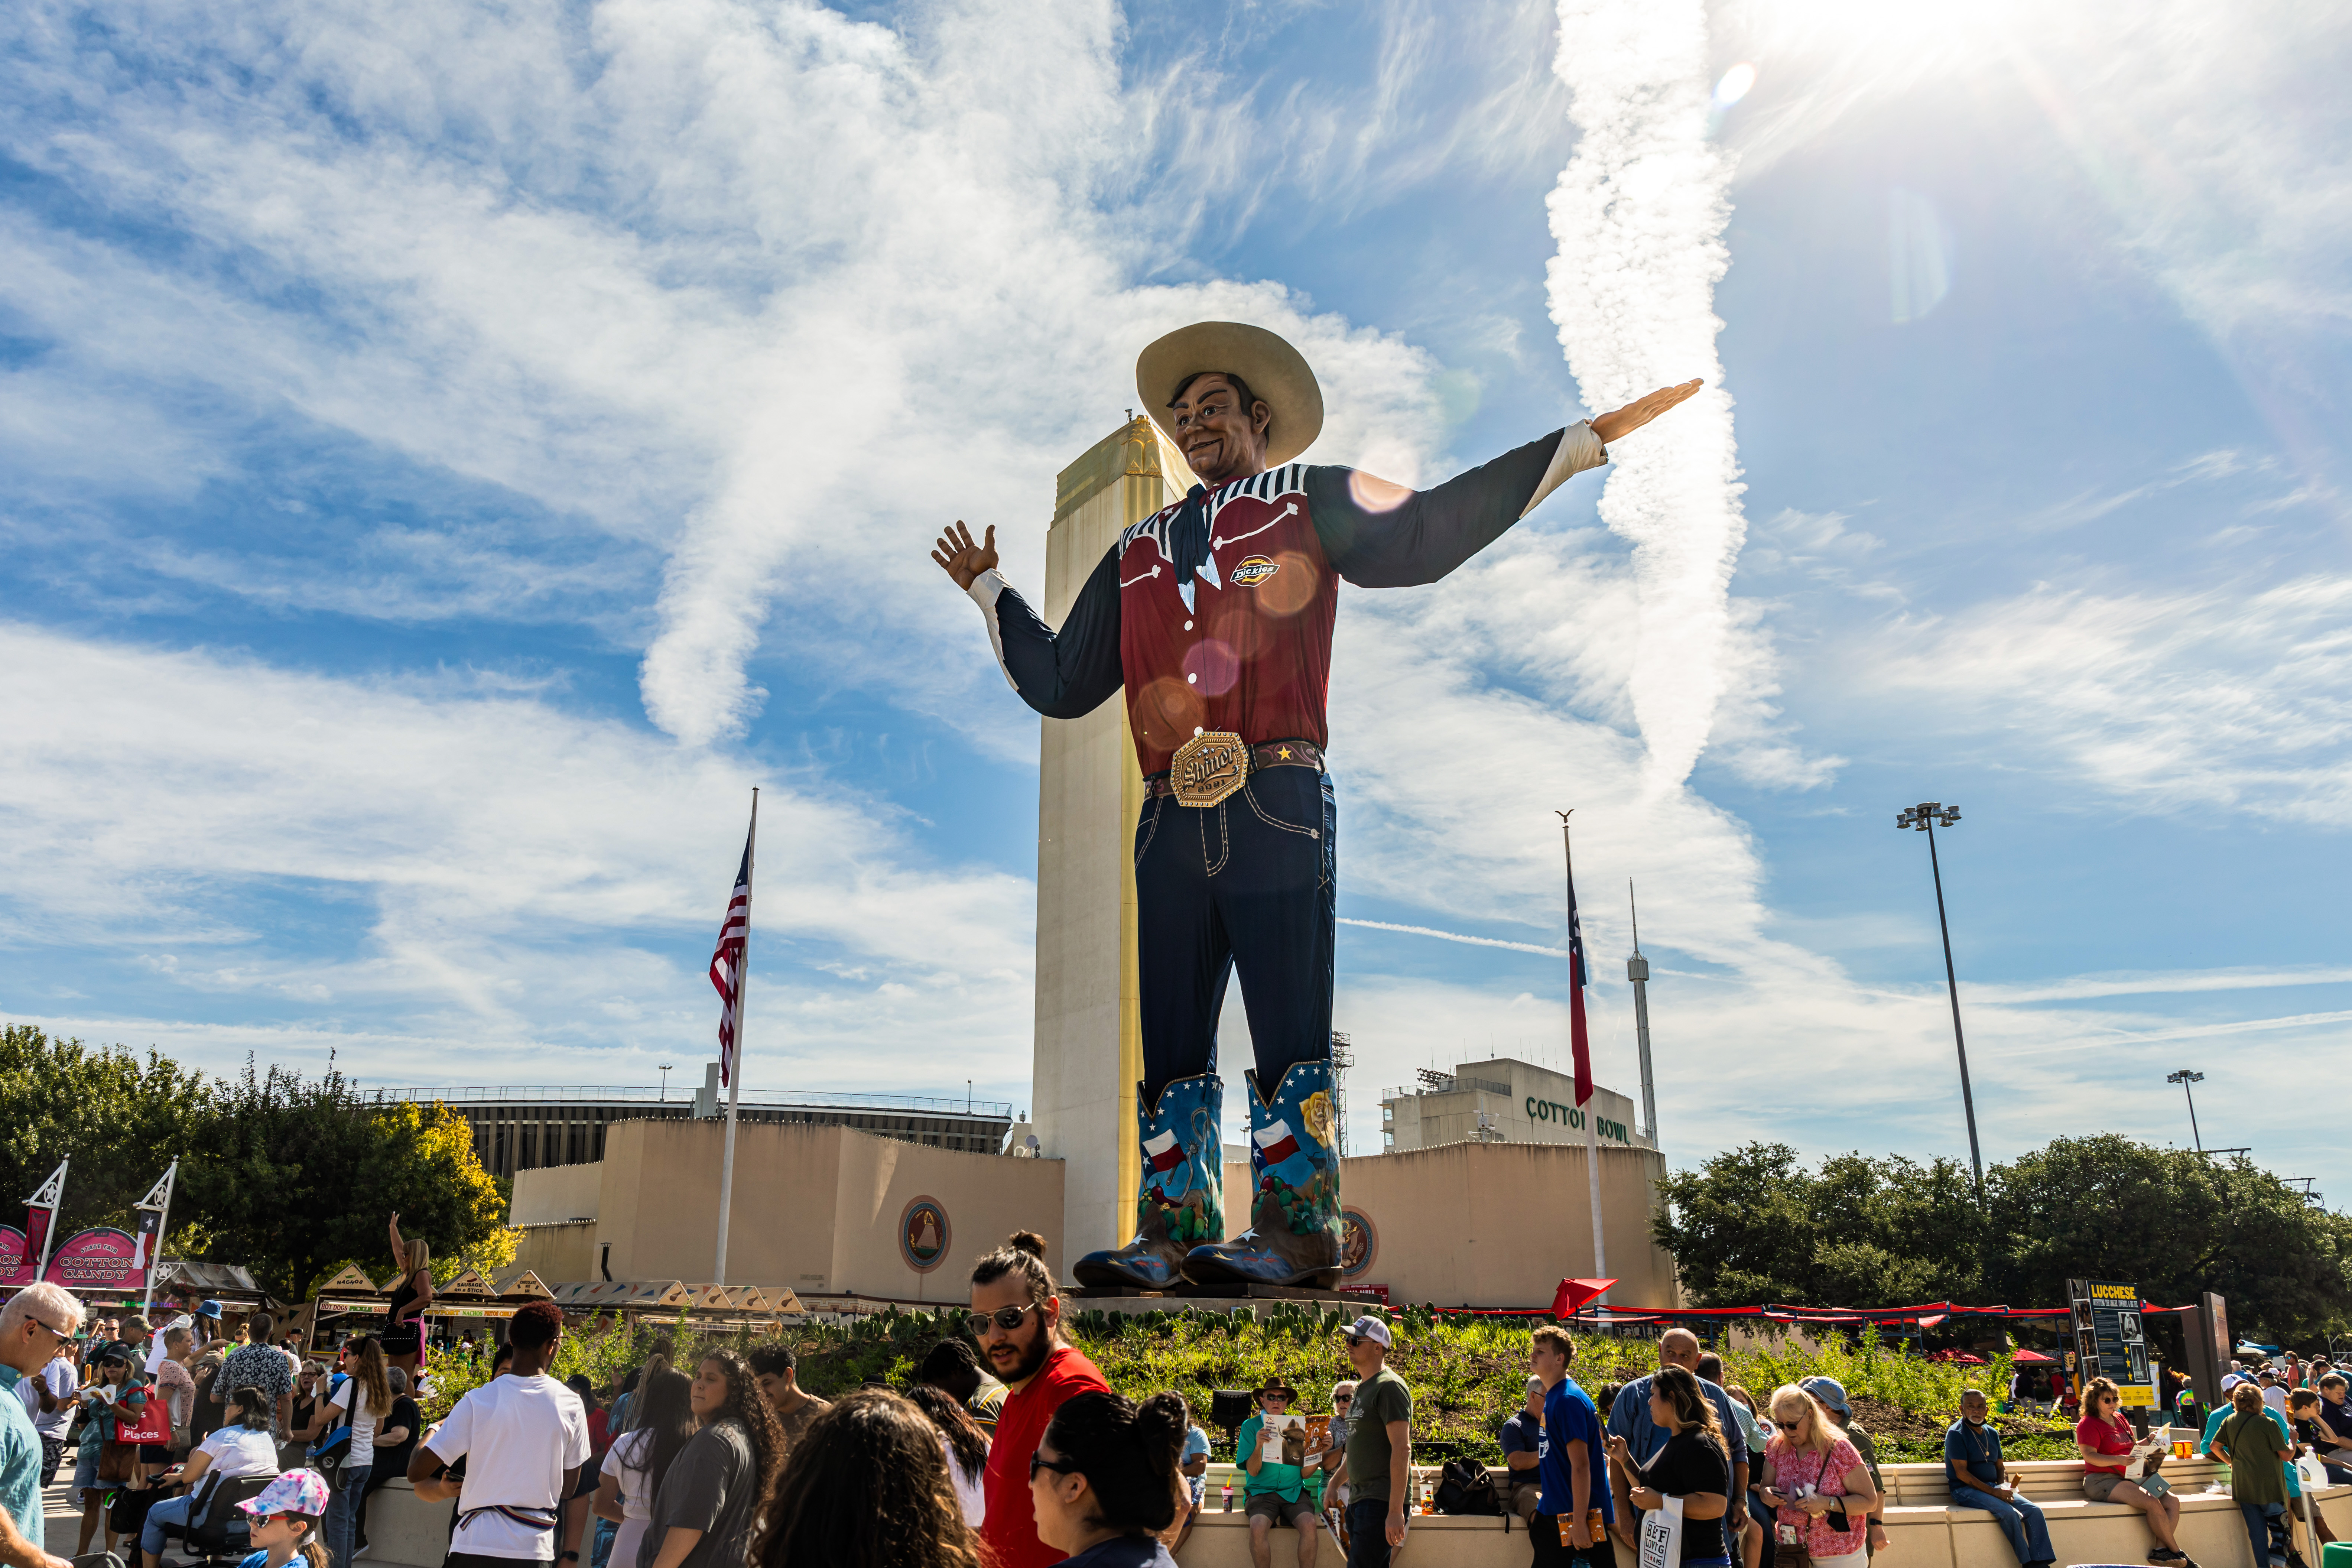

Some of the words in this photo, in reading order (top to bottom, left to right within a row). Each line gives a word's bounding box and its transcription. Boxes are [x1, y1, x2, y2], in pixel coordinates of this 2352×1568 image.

[1234, 566, 1274, 579] Dickies
[1183, 745, 1238, 792] Shiner
[1198, 779, 1225, 793] 2021
[1597, 1116, 1631, 1144] BOWL
[0, 1242, 10, 1251] AIR
[81, 1243, 101, 1254] STATE
[103, 1244, 118, 1254] FAIR
[0, 1255, 23, 1265] ON
[60, 1257, 134, 1267] COTTON
[0, 1267, 19, 1276] DY
[63, 1269, 129, 1279] CANDY
[2091, 1284, 2137, 1299] LUCCHESE
[124, 1429, 159, 1439] Places
[1646, 1538, 1664, 1554] LOVIG
